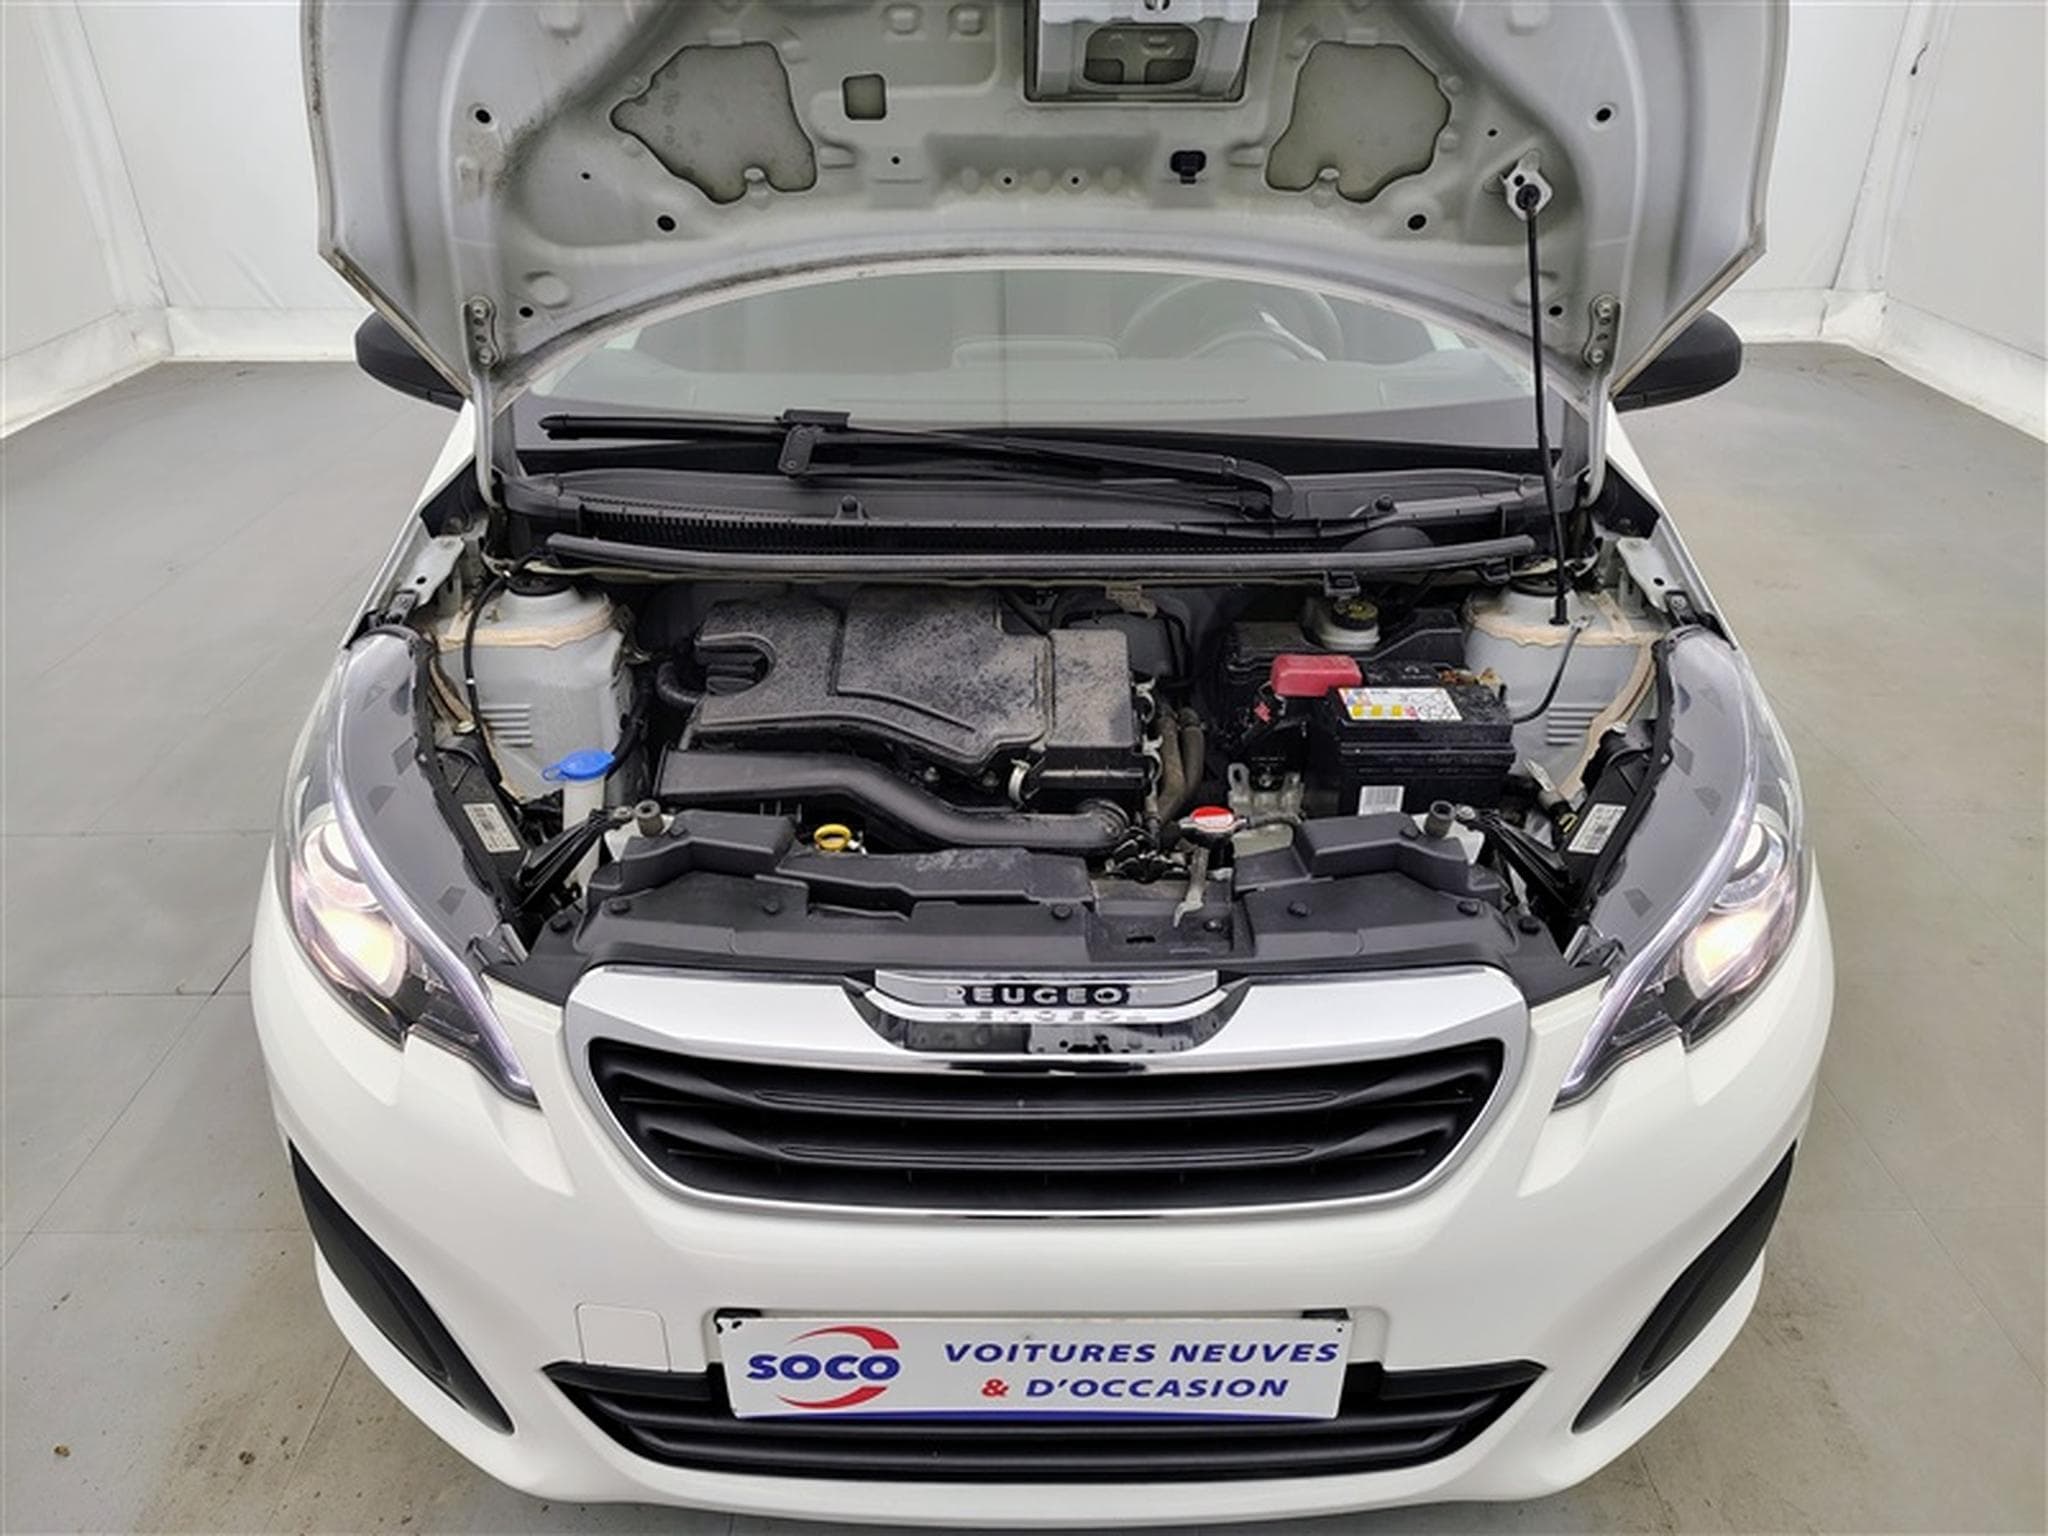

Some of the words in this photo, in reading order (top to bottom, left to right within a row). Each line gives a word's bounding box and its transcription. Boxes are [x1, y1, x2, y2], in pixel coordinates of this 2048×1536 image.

[943, 1342, 1156, 1364] VOITURES
[1169, 1342, 1339, 1363] NEUVES
[746, 1353, 901, 1382] SOCO
[981, 1378, 1009, 1399] &
[1026, 1378, 1289, 1399] D'OCCASION
